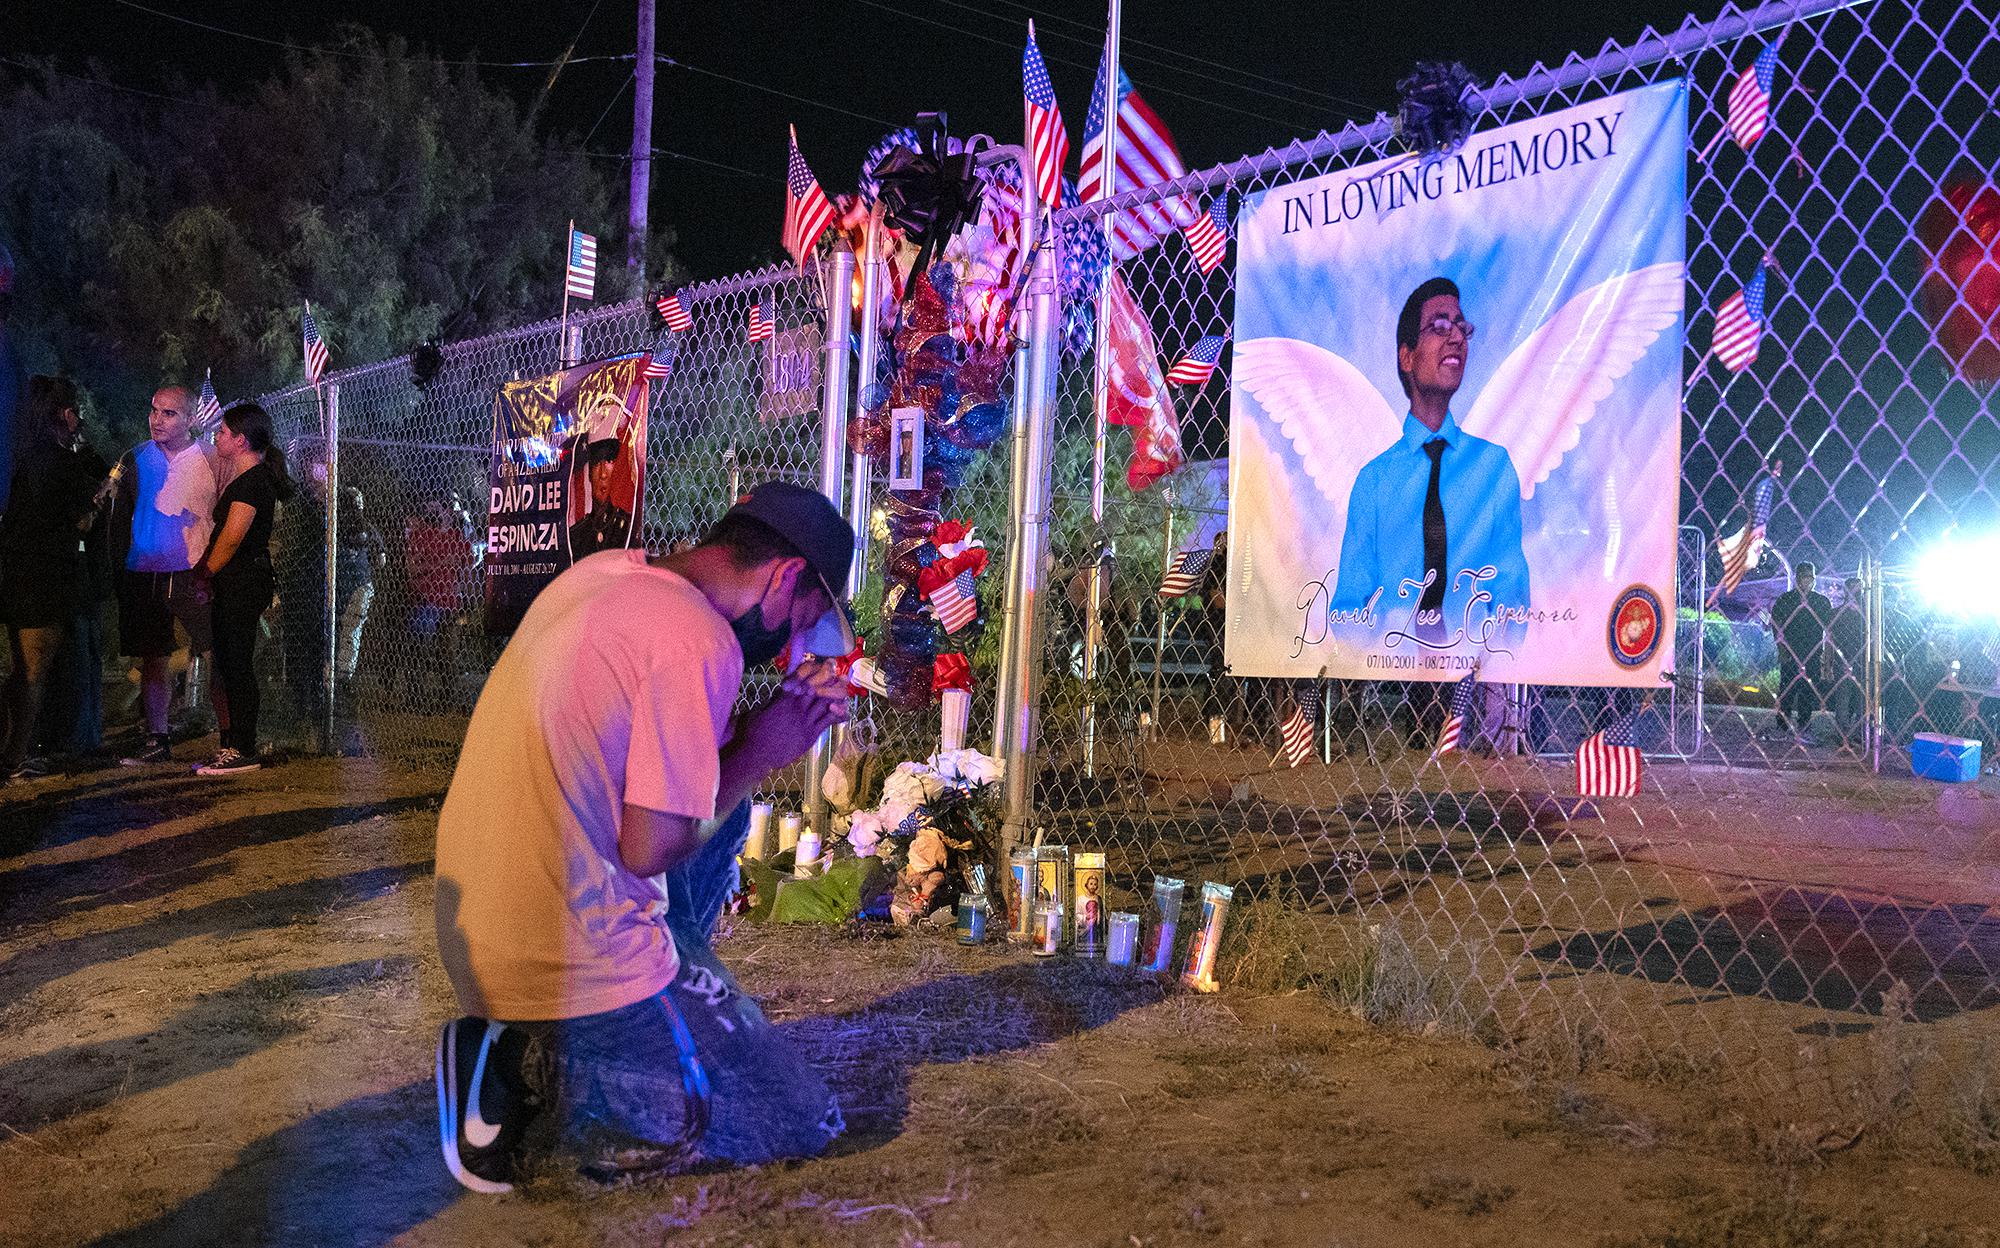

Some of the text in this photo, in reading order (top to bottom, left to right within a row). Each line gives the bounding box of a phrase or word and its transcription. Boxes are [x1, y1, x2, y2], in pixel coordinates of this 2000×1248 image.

[1282, 111, 1624, 235] IN LOVING MEMORY
[538, 480, 561, 511] LEE
[1289, 565, 1579, 661] David Lee Espinoza
[1366, 654, 1416, 670] 07/10/2001
